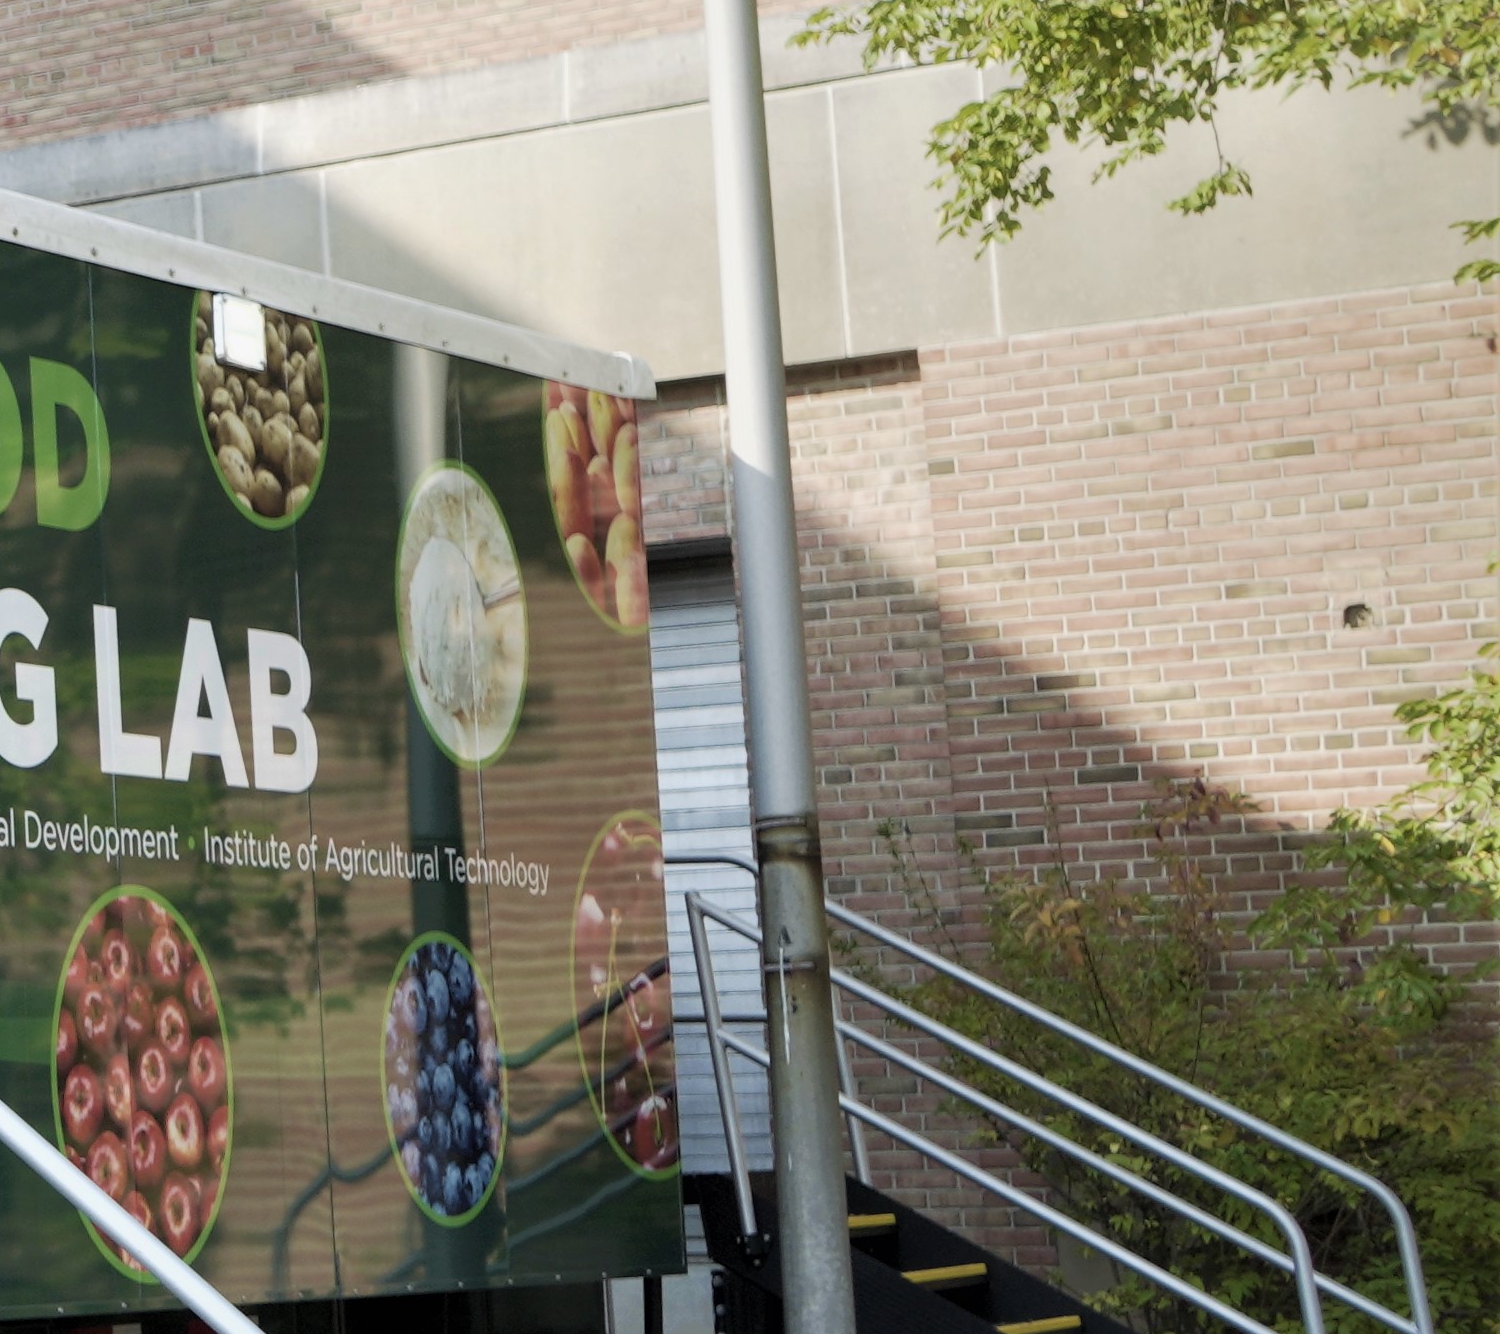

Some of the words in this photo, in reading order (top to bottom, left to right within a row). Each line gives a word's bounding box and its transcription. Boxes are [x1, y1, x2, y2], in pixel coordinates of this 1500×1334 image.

[93, 604, 318, 793] LAB
[23, 810, 180, 863] Development
[204, 827, 291, 870] Institute
[296, 834, 319, 871] of
[324, 837, 440, 881] Agricultural
[444, 847, 550, 896] Technology
